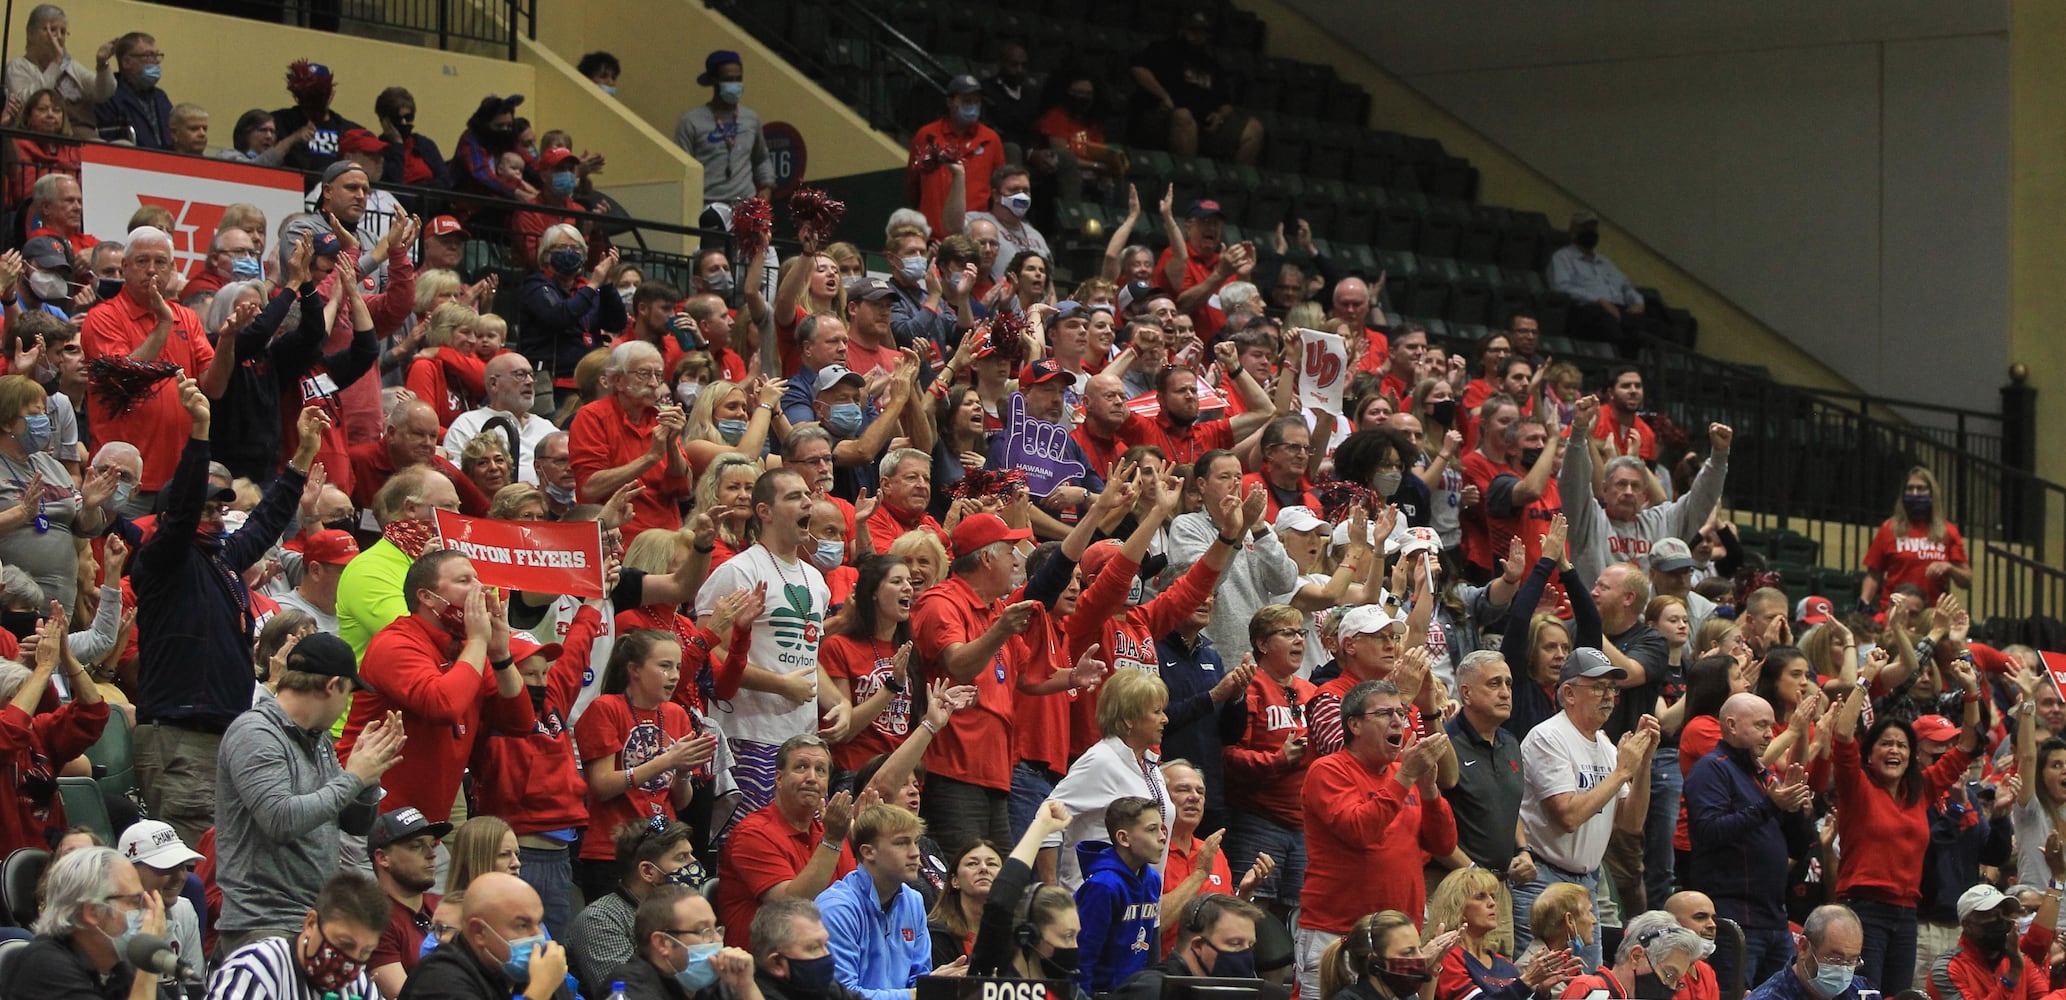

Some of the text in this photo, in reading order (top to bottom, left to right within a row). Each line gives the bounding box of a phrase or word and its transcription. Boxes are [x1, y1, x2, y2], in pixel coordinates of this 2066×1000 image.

[1306, 339, 1341, 388] UD
[1016, 463, 1054, 478] HAWAIIAN
[447, 539, 587, 569] DAYTON FLYERS
[779, 653, 815, 667] dayton
